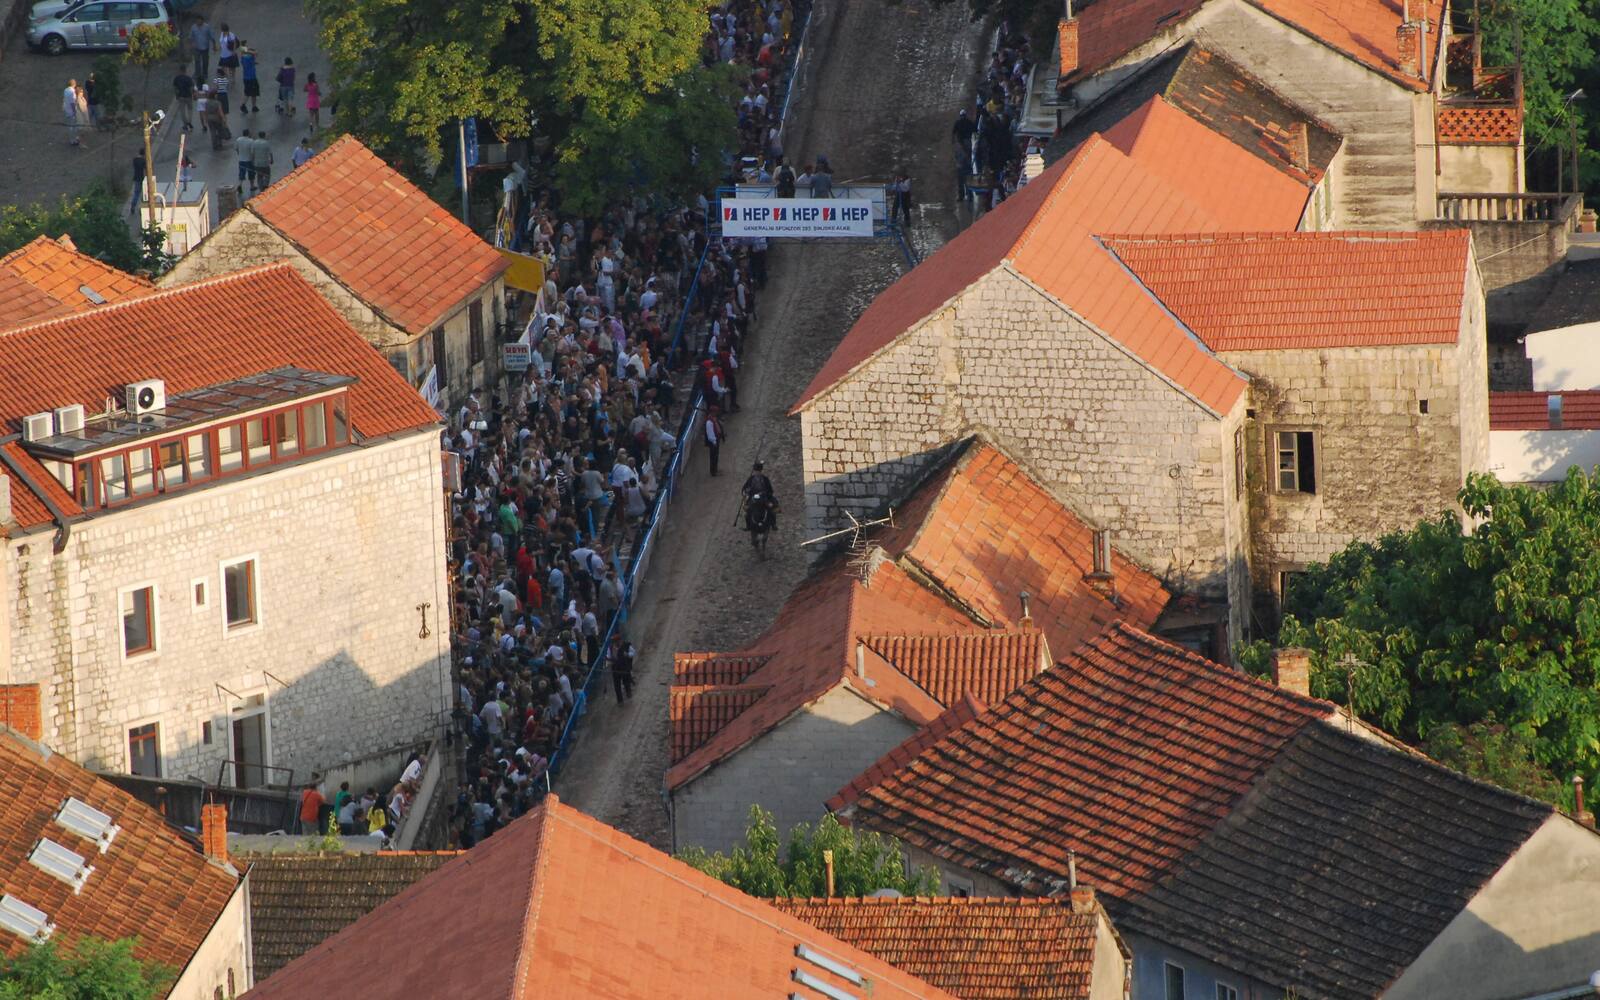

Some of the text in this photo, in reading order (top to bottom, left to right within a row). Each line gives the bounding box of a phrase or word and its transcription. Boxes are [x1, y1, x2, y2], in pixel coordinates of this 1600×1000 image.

[743, 208, 869, 221] HEP HEP HEP
